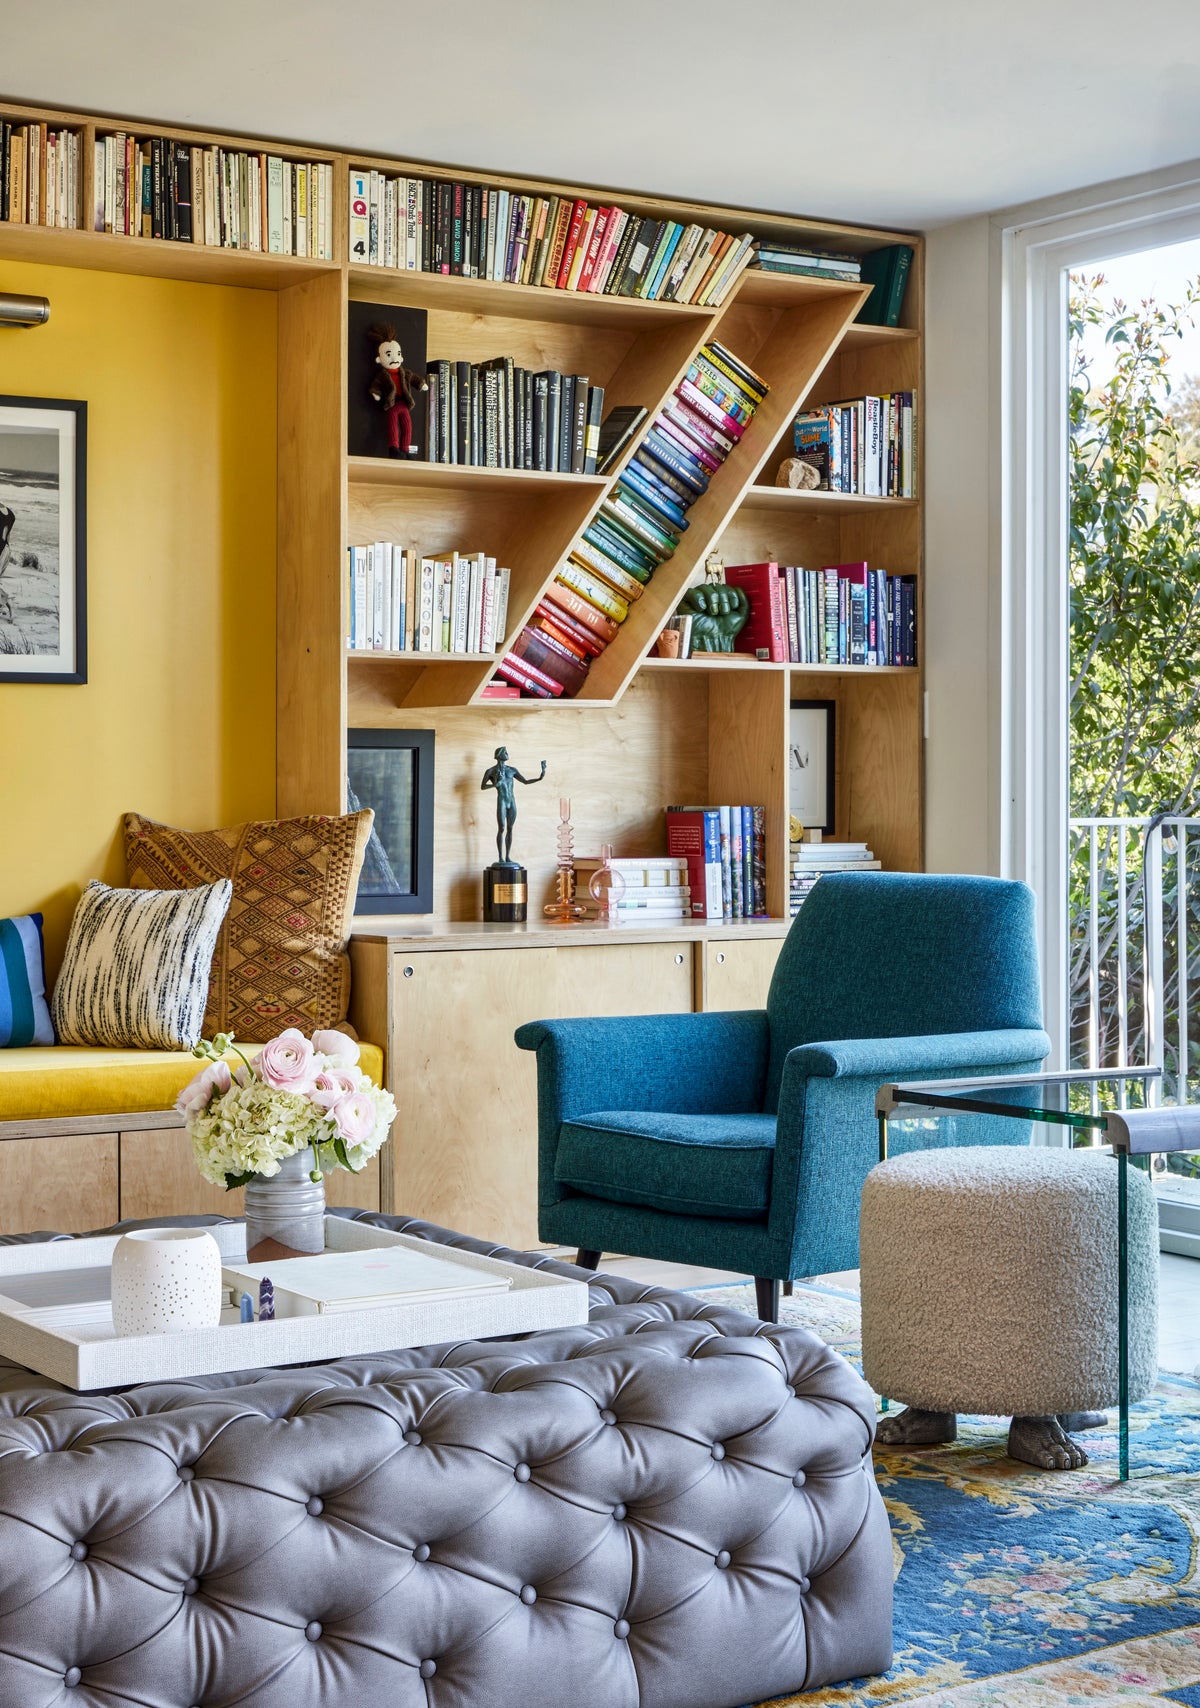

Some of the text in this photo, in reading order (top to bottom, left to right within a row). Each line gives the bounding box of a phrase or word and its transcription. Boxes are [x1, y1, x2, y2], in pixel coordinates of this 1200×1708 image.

[356, 180, 363, 195] 1
[353, 200, 366, 216] Q
[355, 222, 364, 236] 8
[590, 215, 607, 258] THIS TOWN
[354, 241, 365, 255] 4
[550, 205, 570, 280] MICHAEL CHABON
[691, 358, 718, 381] BLITZED
[694, 402, 710, 416] LOVES
[707, 413, 727, 431] COMEDY
[802, 433, 820, 444] SLIME
[357, 558, 365, 573] TV
